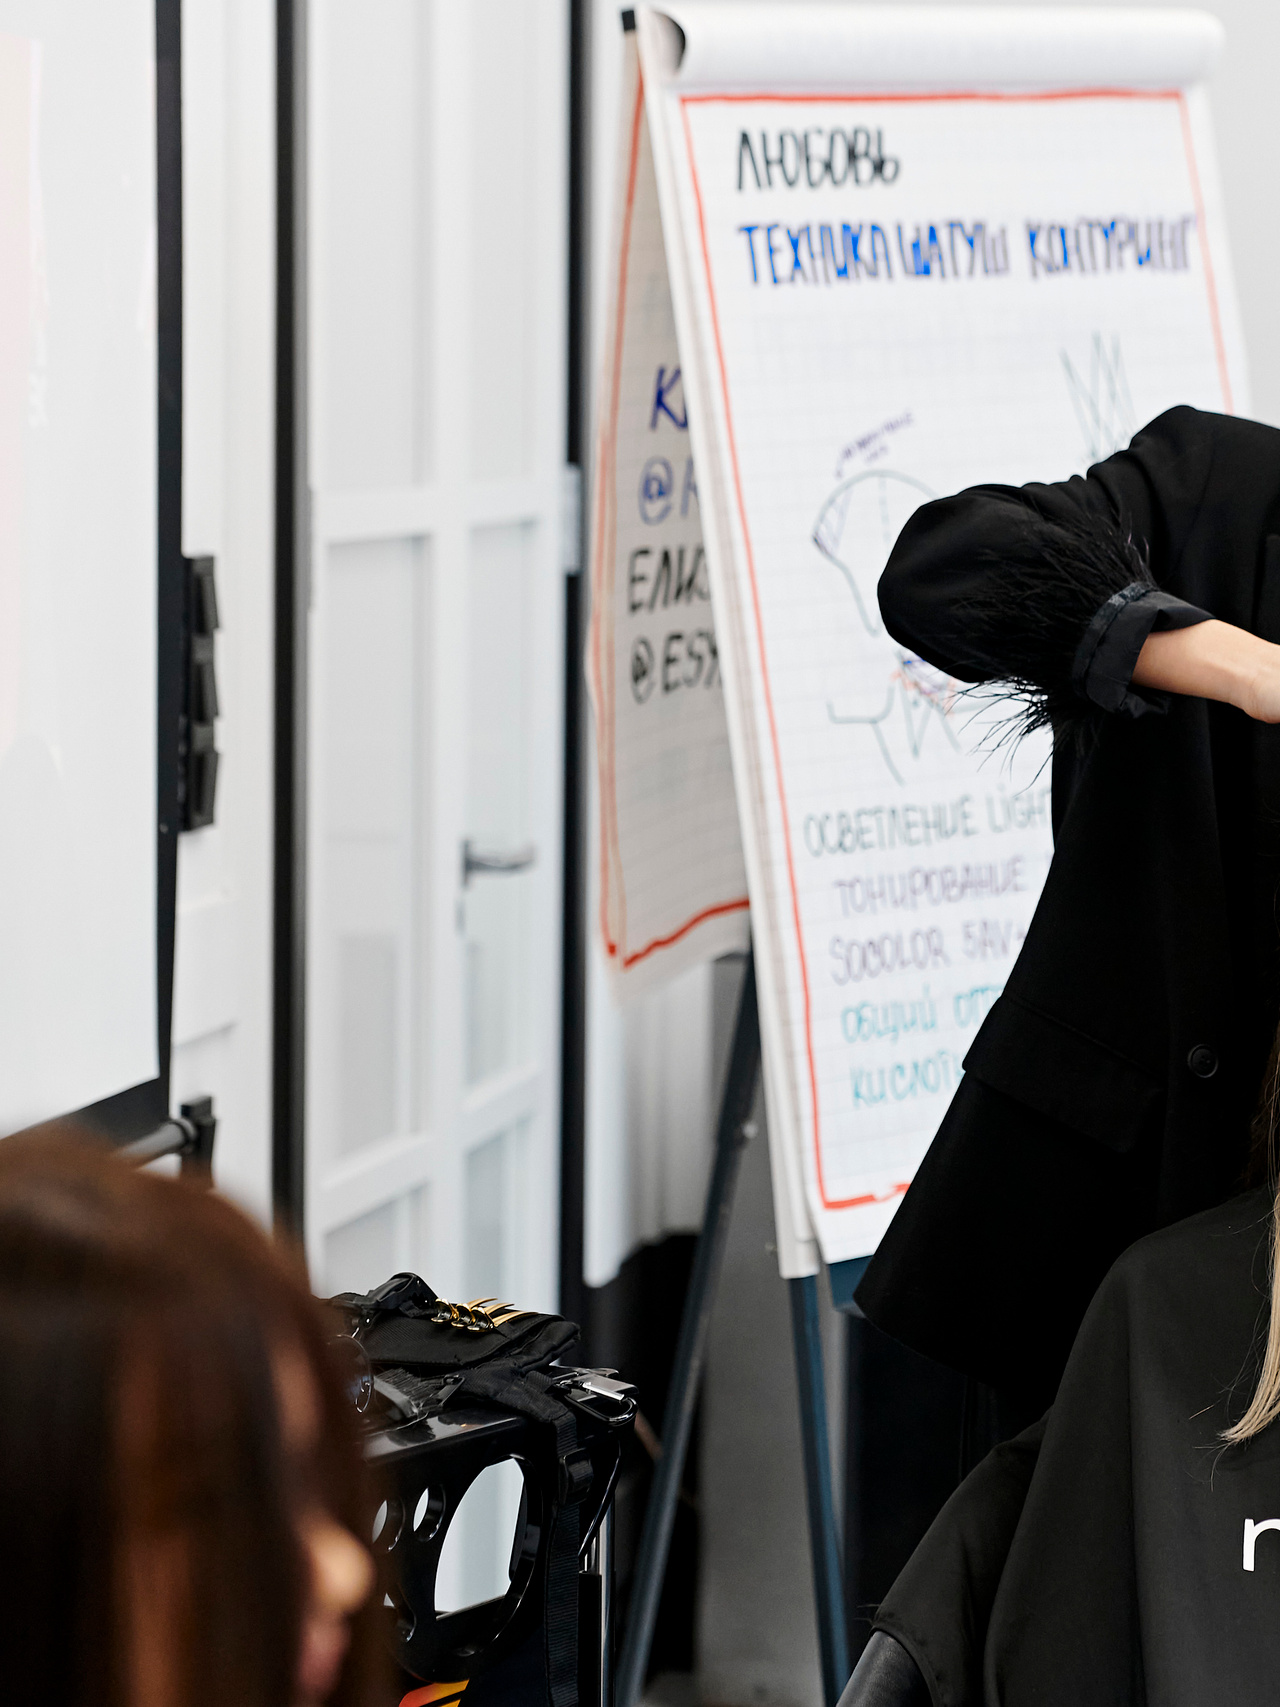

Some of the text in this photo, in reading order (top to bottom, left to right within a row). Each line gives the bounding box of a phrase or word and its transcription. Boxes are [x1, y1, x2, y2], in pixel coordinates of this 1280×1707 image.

[737, 127, 900, 190] ЛЮБОВЬ
[738, 215, 1194, 284] ТЕХНИКА ШАТУШ КОНТУРИНГ
[802, 794, 979, 858] ОСВЕТЛЕНИЕ
[832, 855, 1028, 917] ТОНИРОВАНИЕ
[829, 925, 951, 986] SOCOLOR
[840, 982, 937, 1044] ОБЩИЙ
